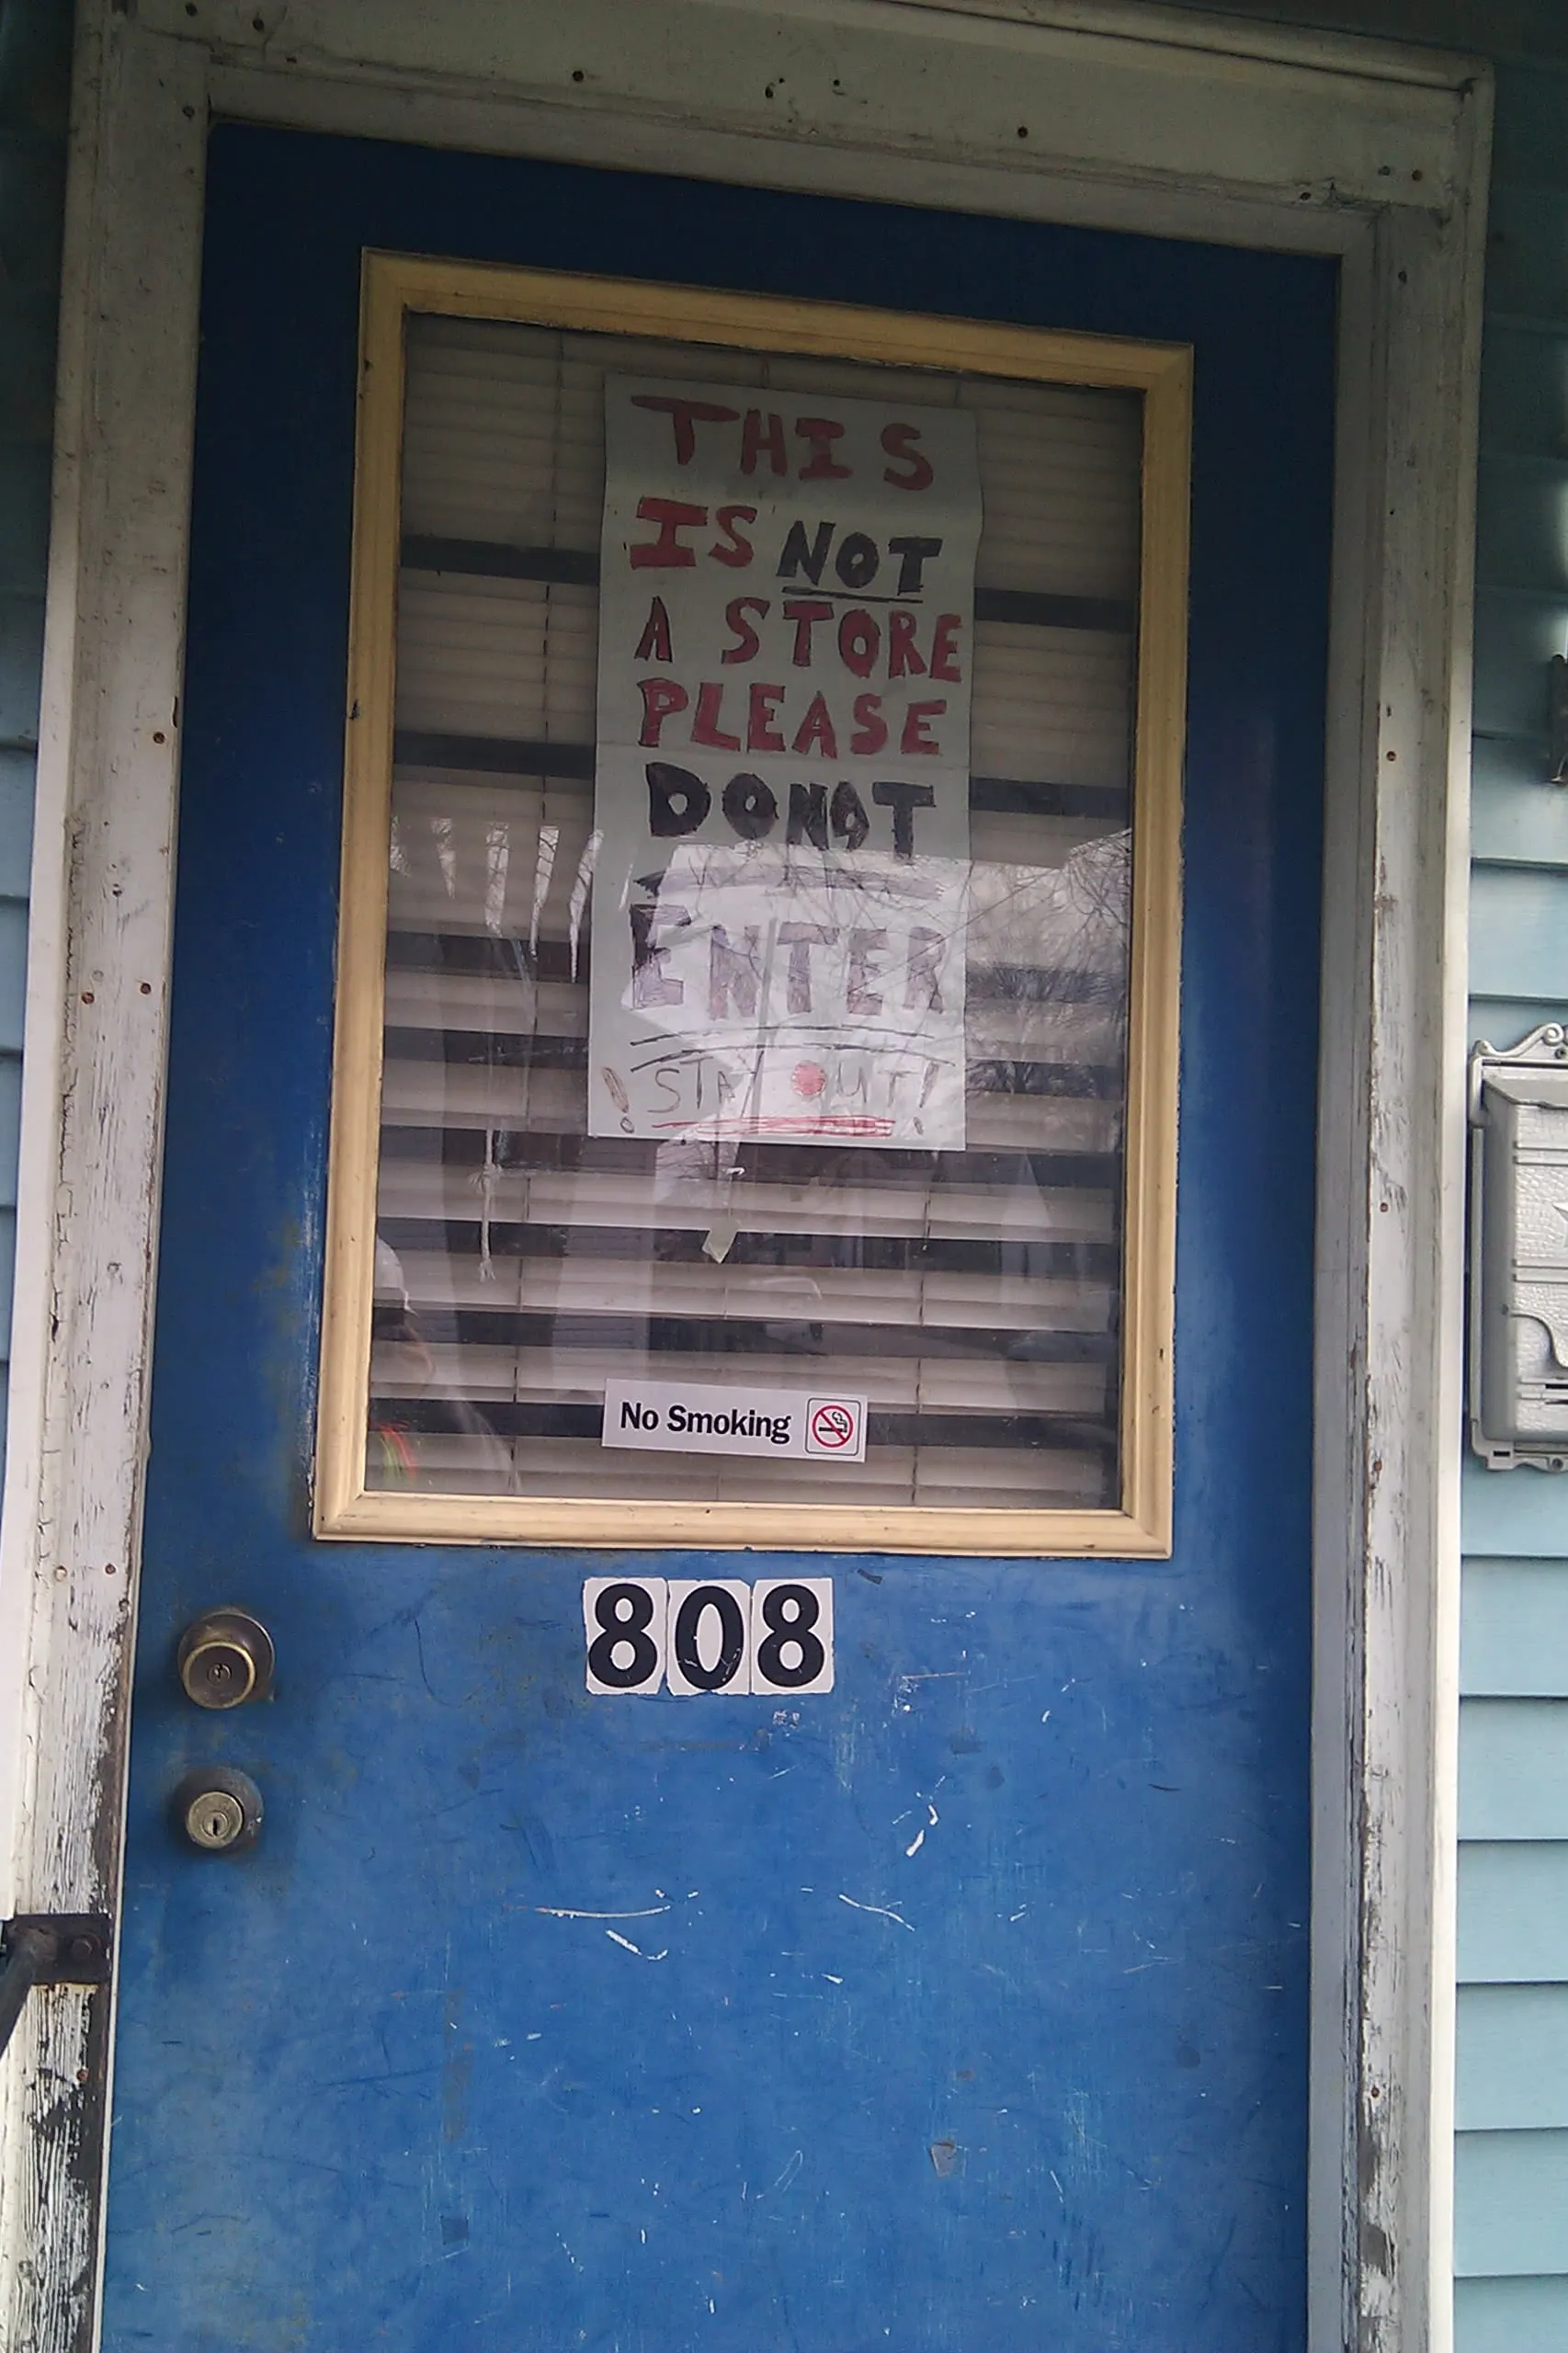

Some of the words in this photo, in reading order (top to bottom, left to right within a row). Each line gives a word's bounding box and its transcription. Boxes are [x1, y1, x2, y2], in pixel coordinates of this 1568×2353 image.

[631, 395, 934, 491] THIS
[630, 496, 757, 570] IS
[776, 520, 944, 597] NOT
[634, 595, 674, 663] A
[721, 596, 963, 682] STORE
[636, 676, 948, 759] PLEASE
[629, 903, 947, 1021] ENTER
[620, 1401, 660, 1431] No
[667, 1404, 792, 1445] Smoking
[587, 1583, 825, 1691] 808
